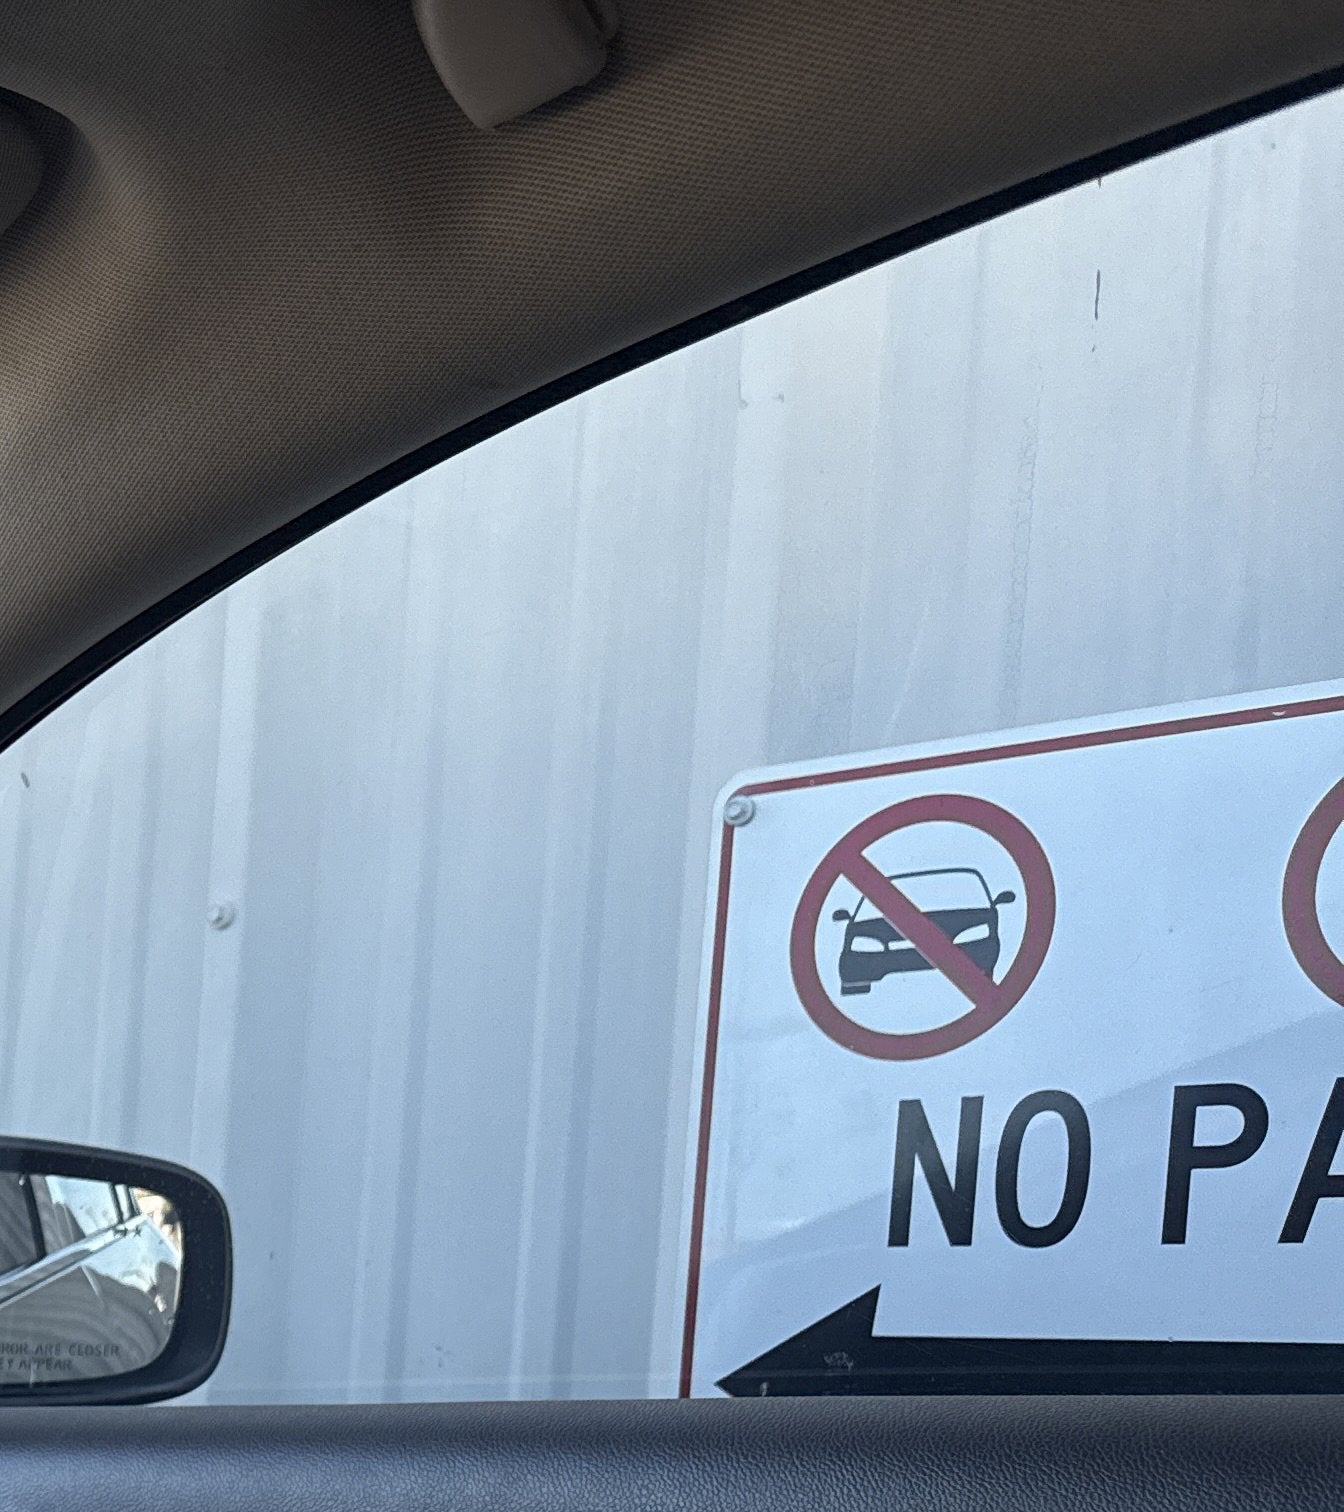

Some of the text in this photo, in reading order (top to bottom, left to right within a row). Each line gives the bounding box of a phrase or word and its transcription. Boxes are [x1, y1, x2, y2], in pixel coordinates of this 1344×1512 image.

[887, 1089, 1091, 1248] NO
[34, 1343, 61, 1356] ARE
[69, 1343, 120, 1357] CLOSER
[18, 1358, 73, 1371] APPEAR
